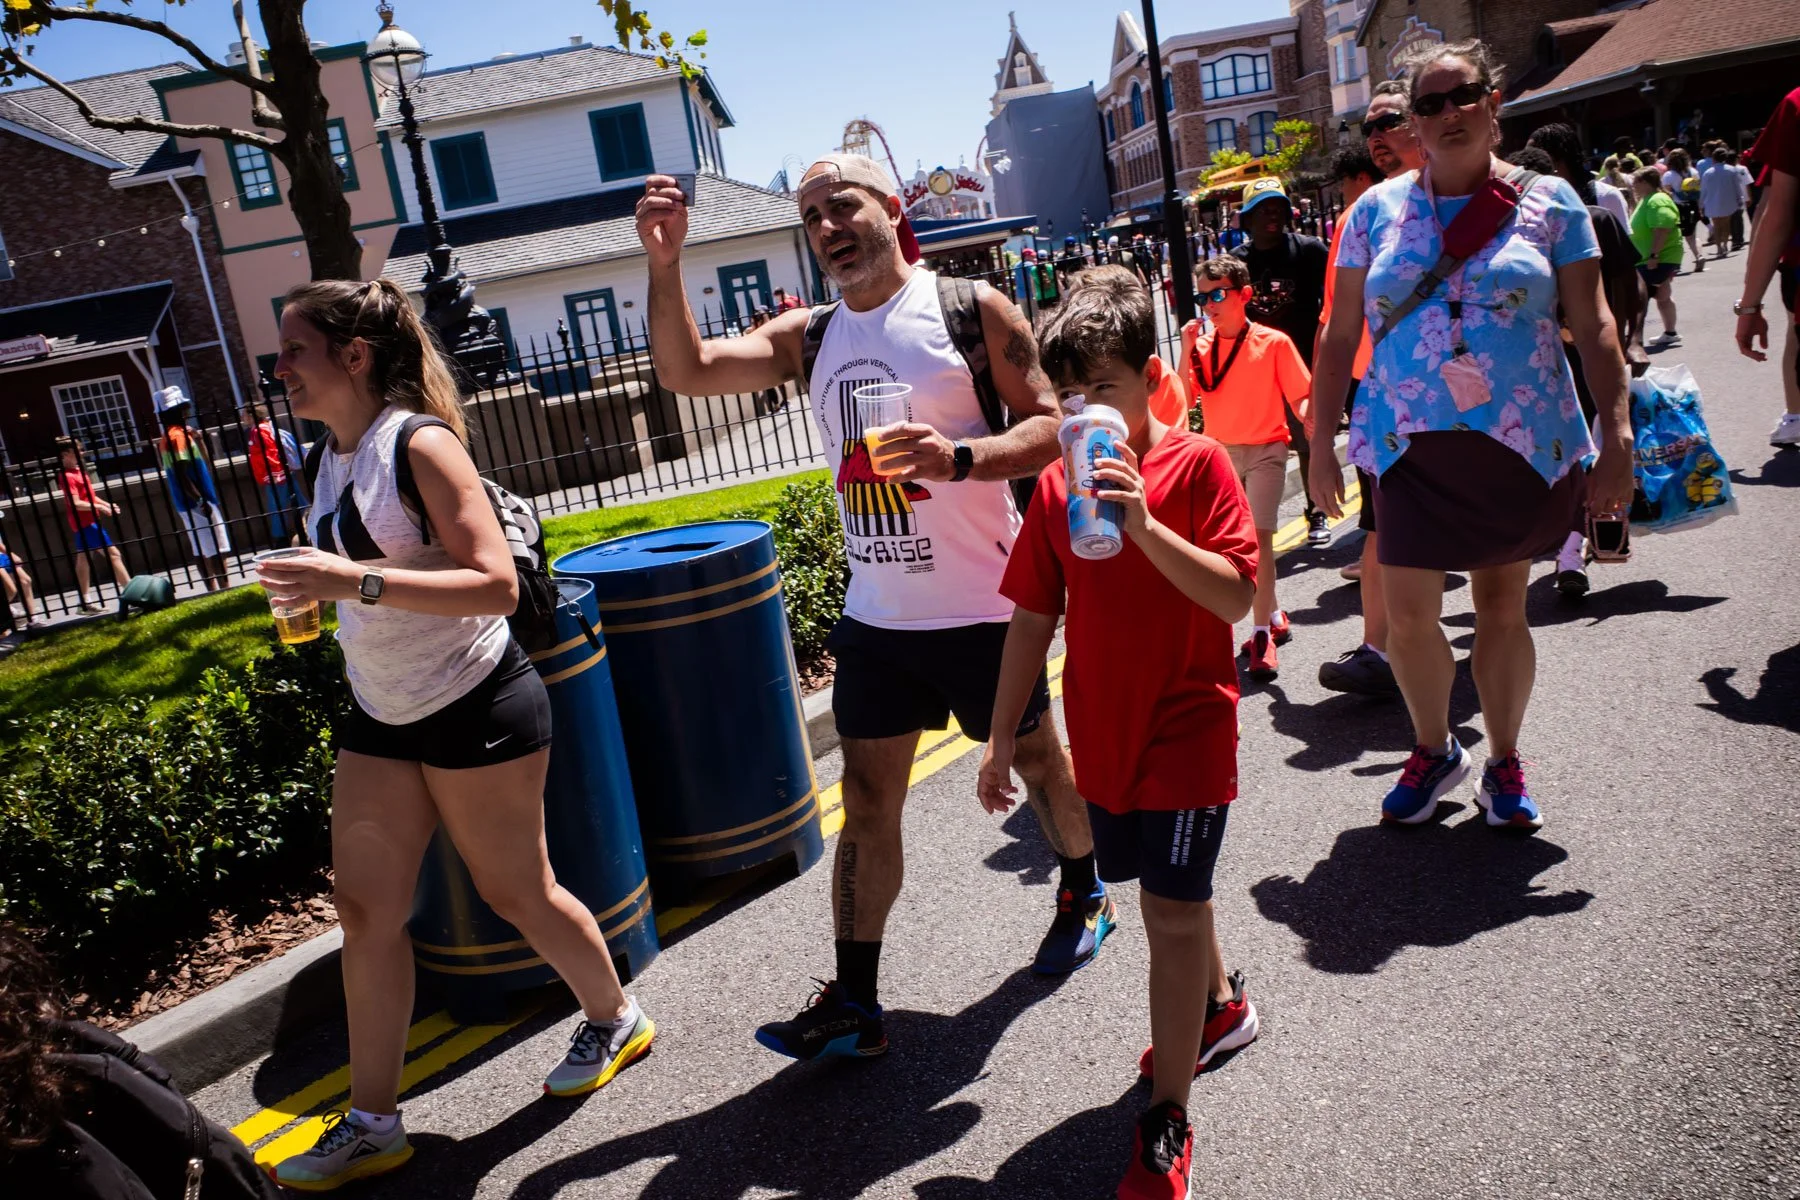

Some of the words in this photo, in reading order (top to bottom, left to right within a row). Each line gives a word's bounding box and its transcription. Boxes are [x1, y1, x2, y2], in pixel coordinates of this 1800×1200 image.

[820, 376, 836, 411] FUTURE
[833, 358, 869, 378] THROUGH
[870, 359, 899, 383] VERTICAL
